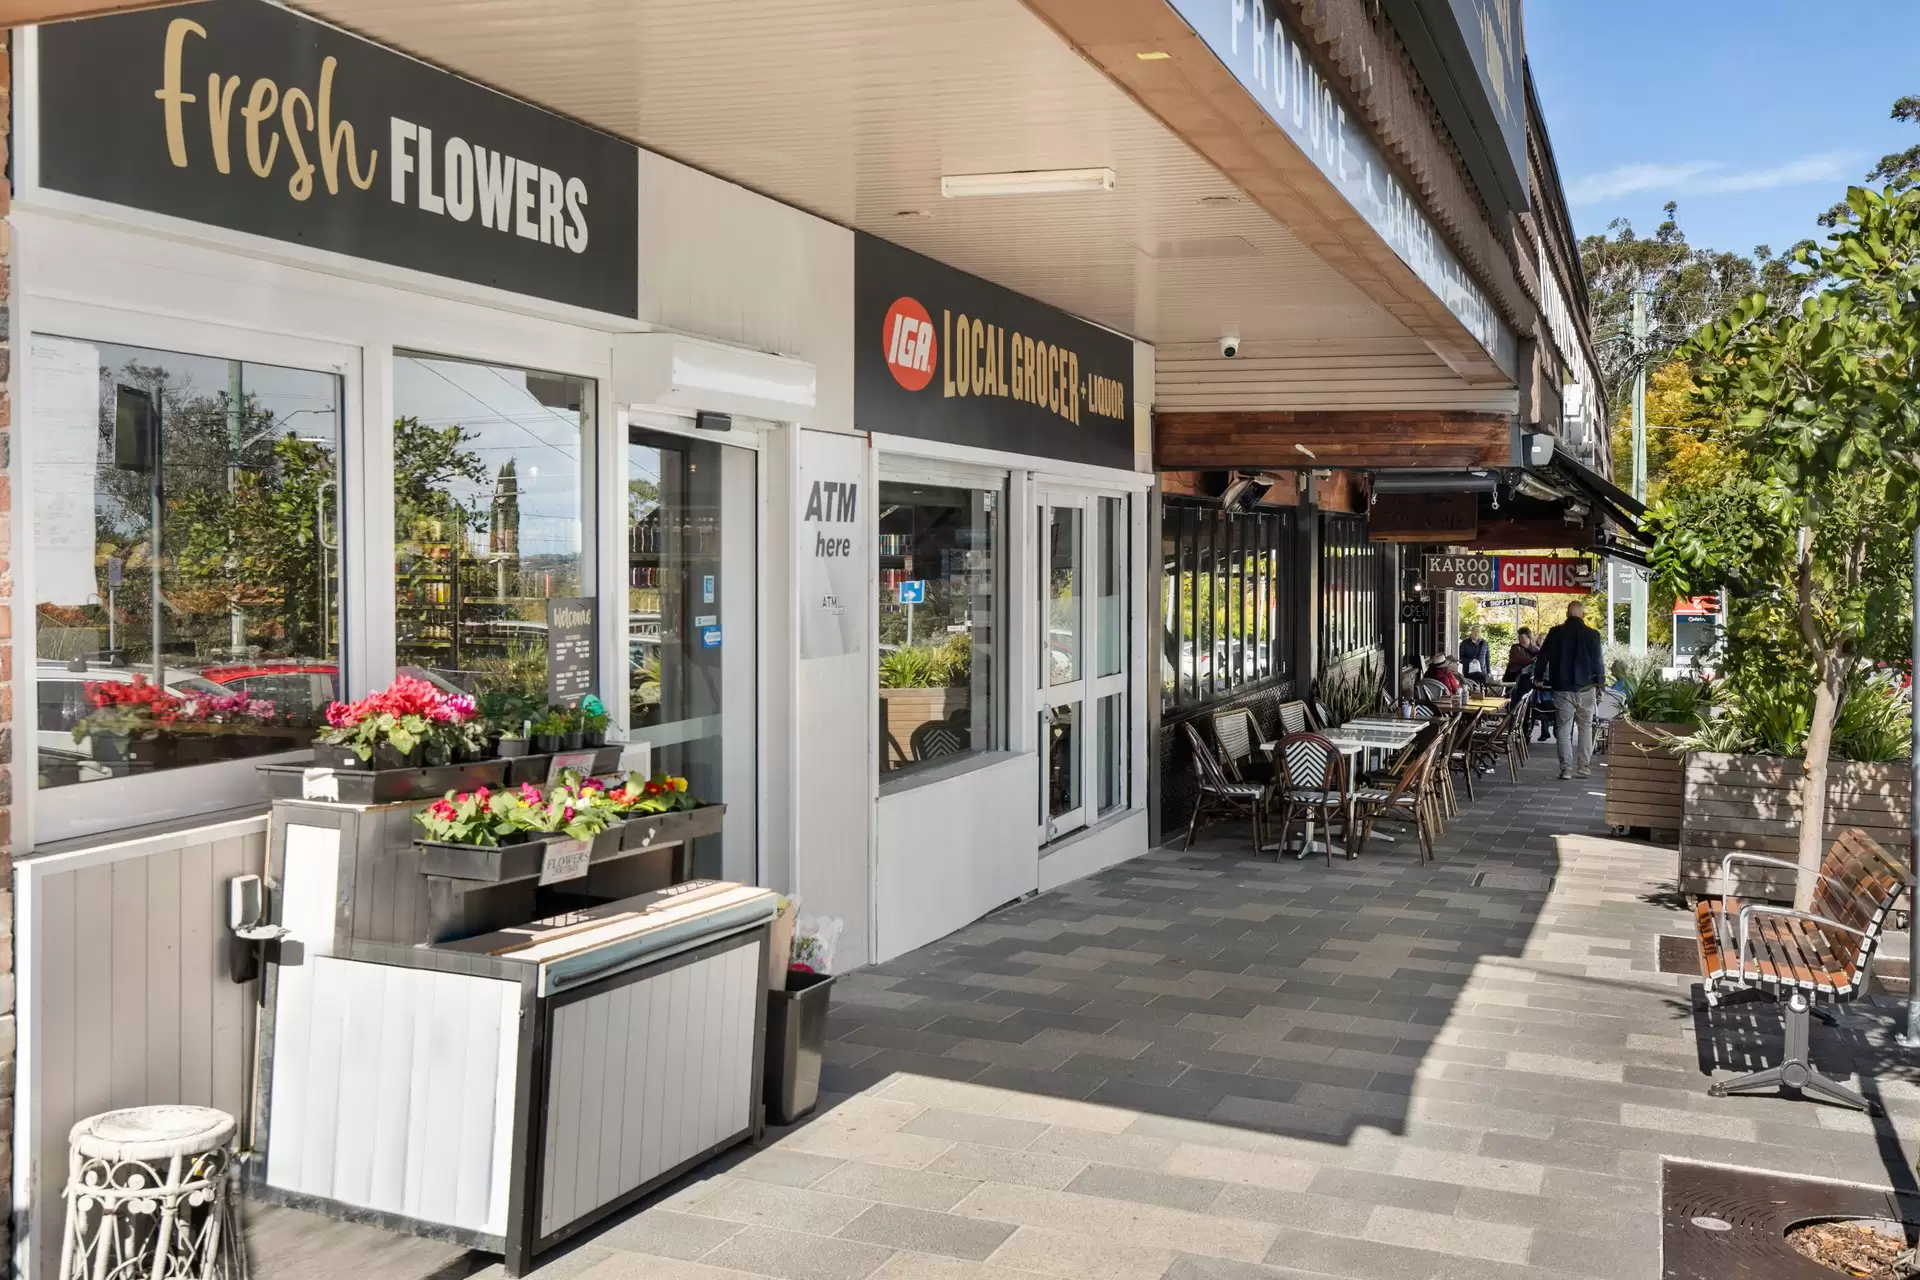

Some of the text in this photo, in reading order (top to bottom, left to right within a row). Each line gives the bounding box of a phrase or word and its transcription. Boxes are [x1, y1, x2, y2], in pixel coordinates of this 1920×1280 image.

[1231, 0, 1347, 183] PRODUCE
[154, 17, 589, 254] fresh FLOWERS
[888, 313, 933, 373] IGA
[943, 308, 1009, 398] LOCAL
[1011, 331, 1080, 427] GROCER
[1088, 373, 1125, 420] LIQUOR
[804, 480, 858, 523] ATM
[815, 530, 851, 557] here
[1429, 558, 1490, 572] KAROO
[1502, 562, 1576, 587] CHEMIS
[820, 595, 838, 609] ATM
[1402, 604, 1429, 618] OPEN
[553, 606, 592, 629] Welcome
[547, 850, 590, 870] FLOWERS
